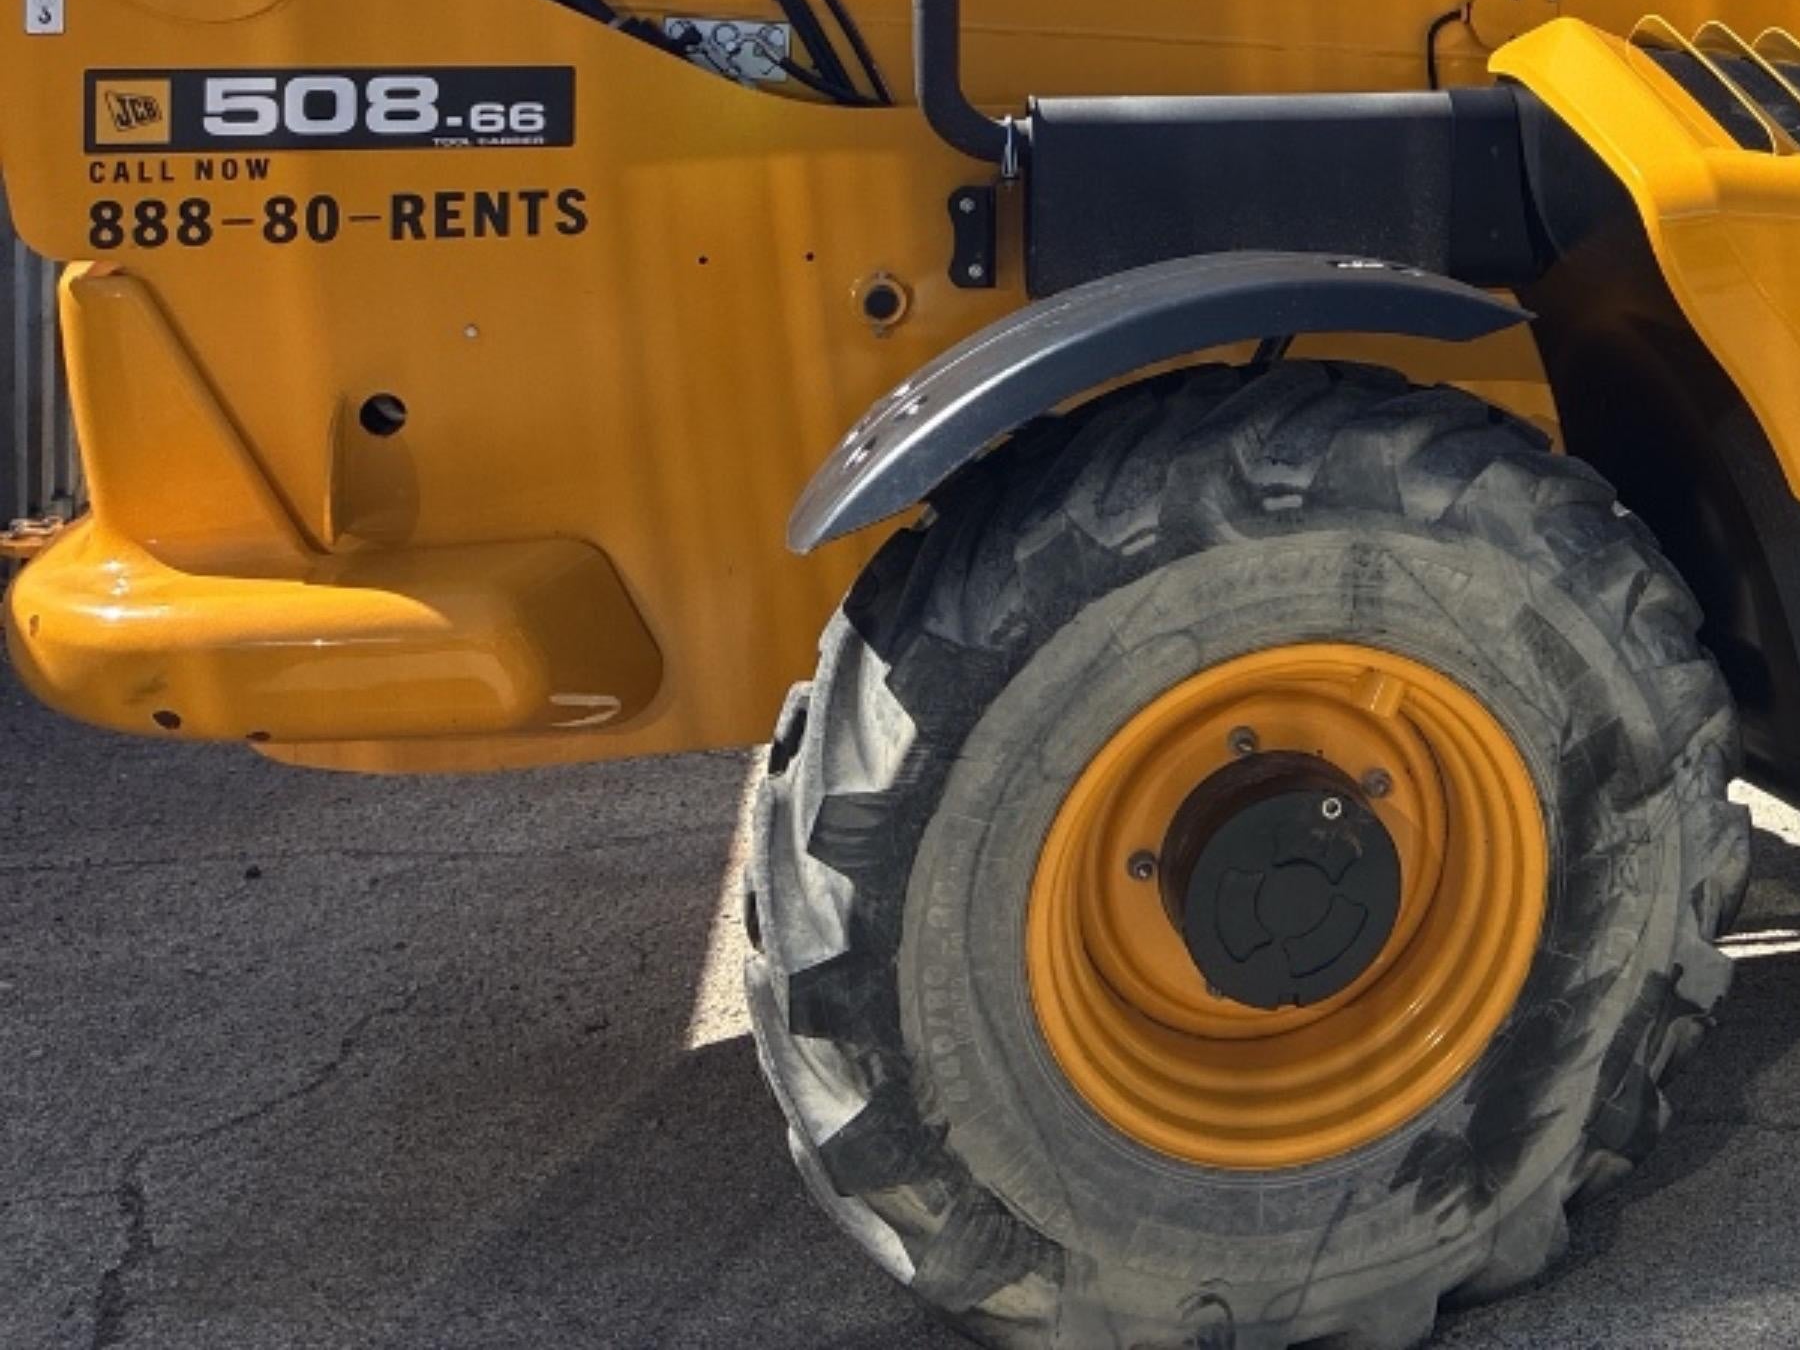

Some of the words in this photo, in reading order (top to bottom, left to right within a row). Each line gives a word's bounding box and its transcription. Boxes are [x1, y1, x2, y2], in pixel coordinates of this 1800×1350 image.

[110, 92, 162, 132] JCB
[89, 160, 175, 183] CALL
[195, 158, 271, 181] NOW
[89, 188, 588, 249] 888-80-RENTS
